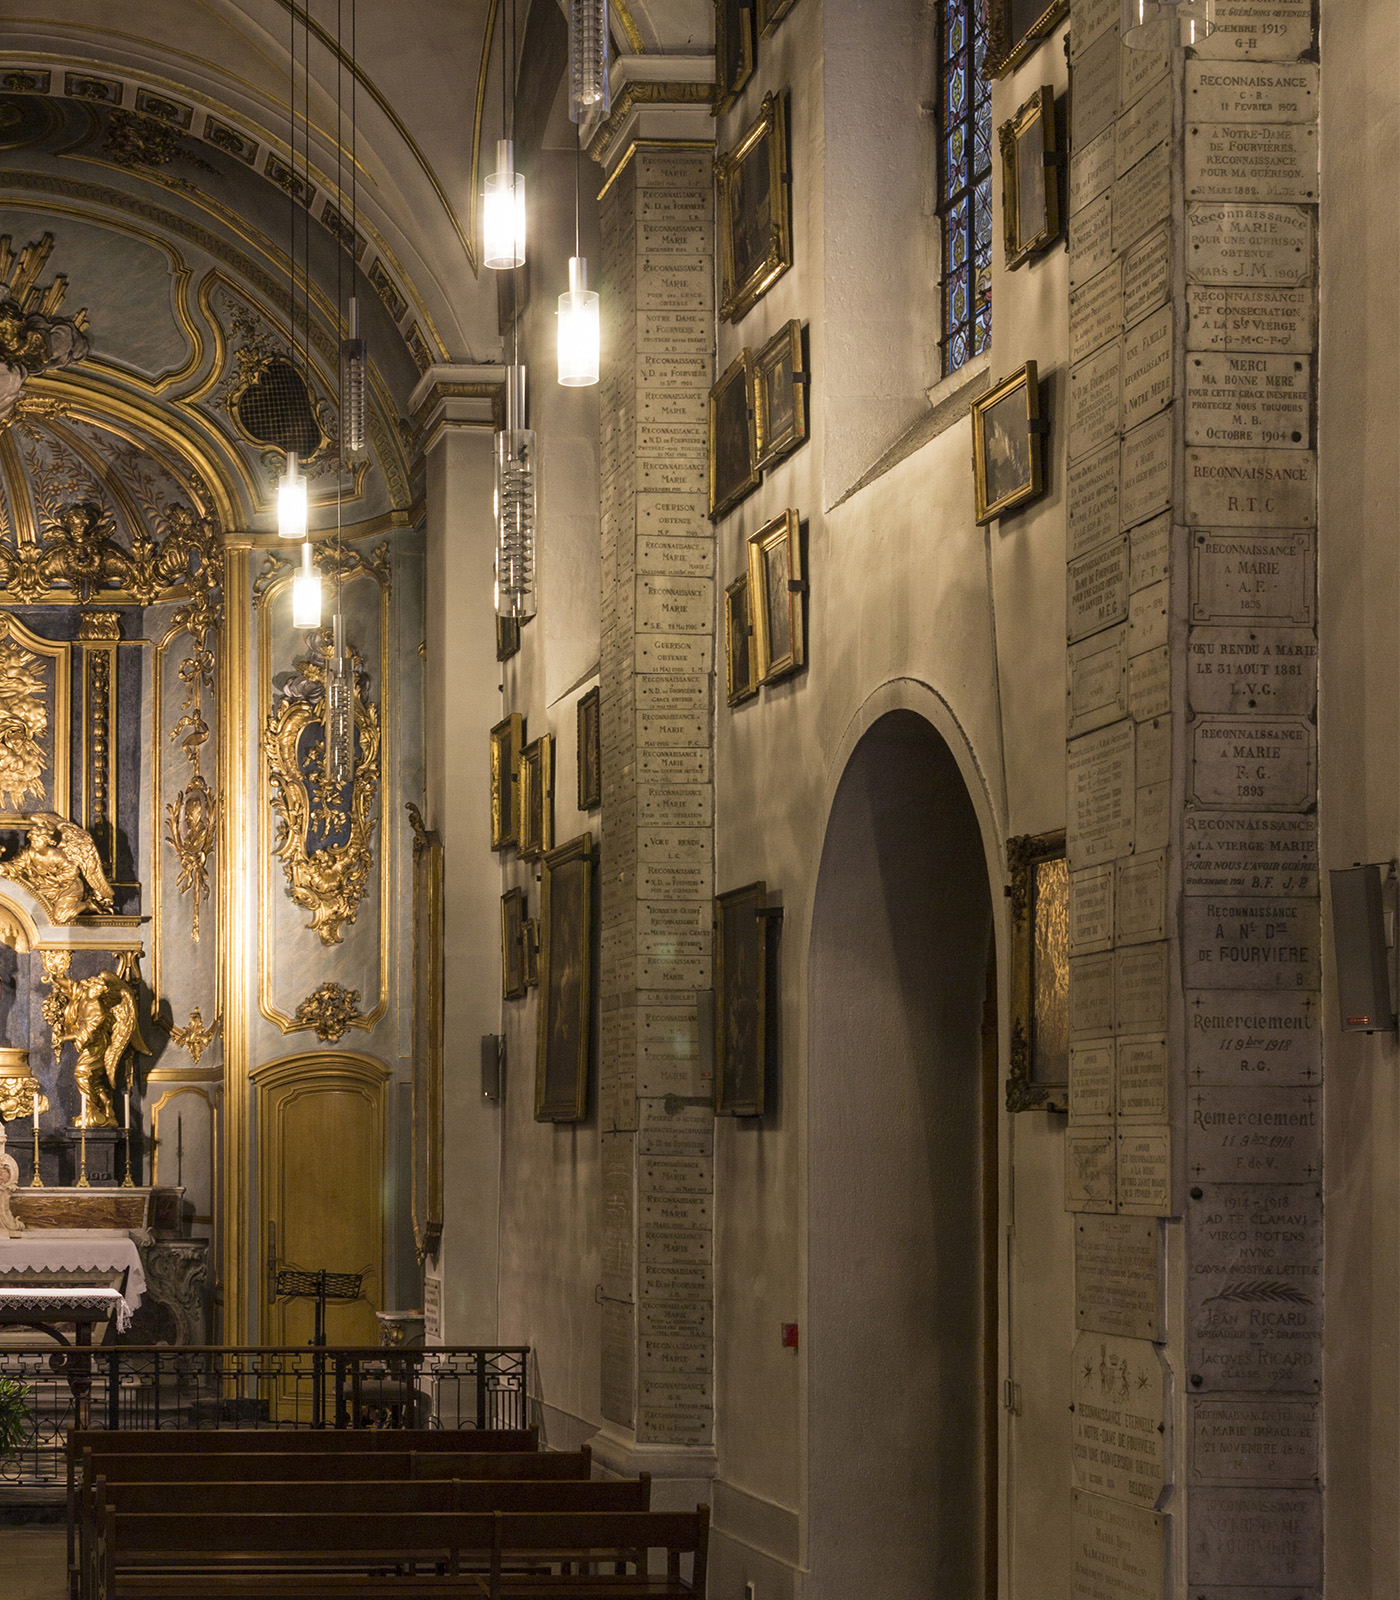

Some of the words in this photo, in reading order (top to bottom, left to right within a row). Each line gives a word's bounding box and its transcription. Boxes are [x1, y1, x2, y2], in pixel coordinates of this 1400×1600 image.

[1262, 24, 1287, 36] 1919
[1200, 75, 1307, 88] RECONNAISSANCE
[1210, 143, 1224, 151] DE
[1206, 156, 1297, 166] RECONNAISSANCE
[1200, 169, 1227, 177] POUR
[1190, 209, 1307, 229] Reconnaissance
[643, 225, 702, 233] RECONNAISSANCE
[1229, 223, 1278, 233] MARIE
[662, 236, 688, 244] MARIE
[1191, 236, 1220, 244] POUR
[1224, 237, 1246, 245] UNE
[1221, 249, 1274, 258] OBTENUE
[1197, 267, 1228, 277] MARS
[1193, 292, 1304, 303] RECONNAISSANCE
[1198, 306, 1211, 315] ET
[676, 314, 697, 322] DAME
[1253, 321, 1296, 331] VIERGE
[1229, 360, 1267, 372] MERCI
[1202, 375, 1217, 385] MA
[1225, 374, 1258, 385] BONNE
[1188, 389, 1209, 397] POUR
[1211, 390, 1237, 398] CETTE
[1239, 390, 1265, 398] GRACE
[661, 406, 687, 415] MARIE
[1236, 402, 1257, 411] NOUS
[1261, 403, 1303, 412] TOUJOURS
[1206, 428, 1253, 440] OCTOBRE
[1262, 431, 1286, 443] 1904
[1193, 466, 1308, 480] RECONNAISSANCE
[1206, 544, 1296, 556] RECONNAISSANCE
[1238, 562, 1280, 575] MARIE
[1220, 644, 1259, 655] RENDU
[1275, 645, 1317, 656] MARIE
[1196, 663, 1212, 674] LE
[1218, 664, 1231, 674] 31
[1235, 664, 1269, 675] AOUT
[659, 726, 685, 734] MARIE
[1201, 729, 1303, 739] RECONNAISSANCE
[1233, 746, 1281, 759] MARIE
[1237, 786, 1264, 797] 1895
[1186, 817, 1314, 831] RECONNAISSANCE
[1198, 841, 1213, 850] LA
[1216, 841, 1264, 851] VIERGE
[1270, 841, 1315, 852] MARIE
[1185, 861, 1212, 870] POUR
[1214, 862, 1241, 870] NOUS
[1242, 862, 1280, 871] L'AVOIR
[1207, 904, 1298, 918] RECONNAISSANCE
[1199, 949, 1212, 962] DE
[1220, 947, 1309, 963] FOURVIERE
[1193, 1014, 1312, 1033] Remerciement
[1264, 1039, 1292, 1051] 1918
[1193, 1109, 1316, 1131] Remerciement
[1205, 1214, 1222, 1224] AD
[1209, 1231, 1246, 1241] VIRGO
[1255, 1231, 1305, 1241] POTENS
[663, 1244, 689, 1253] MARIE
[1250, 1309, 1307, 1326] RICARD
[1259, 1349, 1313, 1365] RICARD
[1213, 1427, 1246, 1436] MARIE
